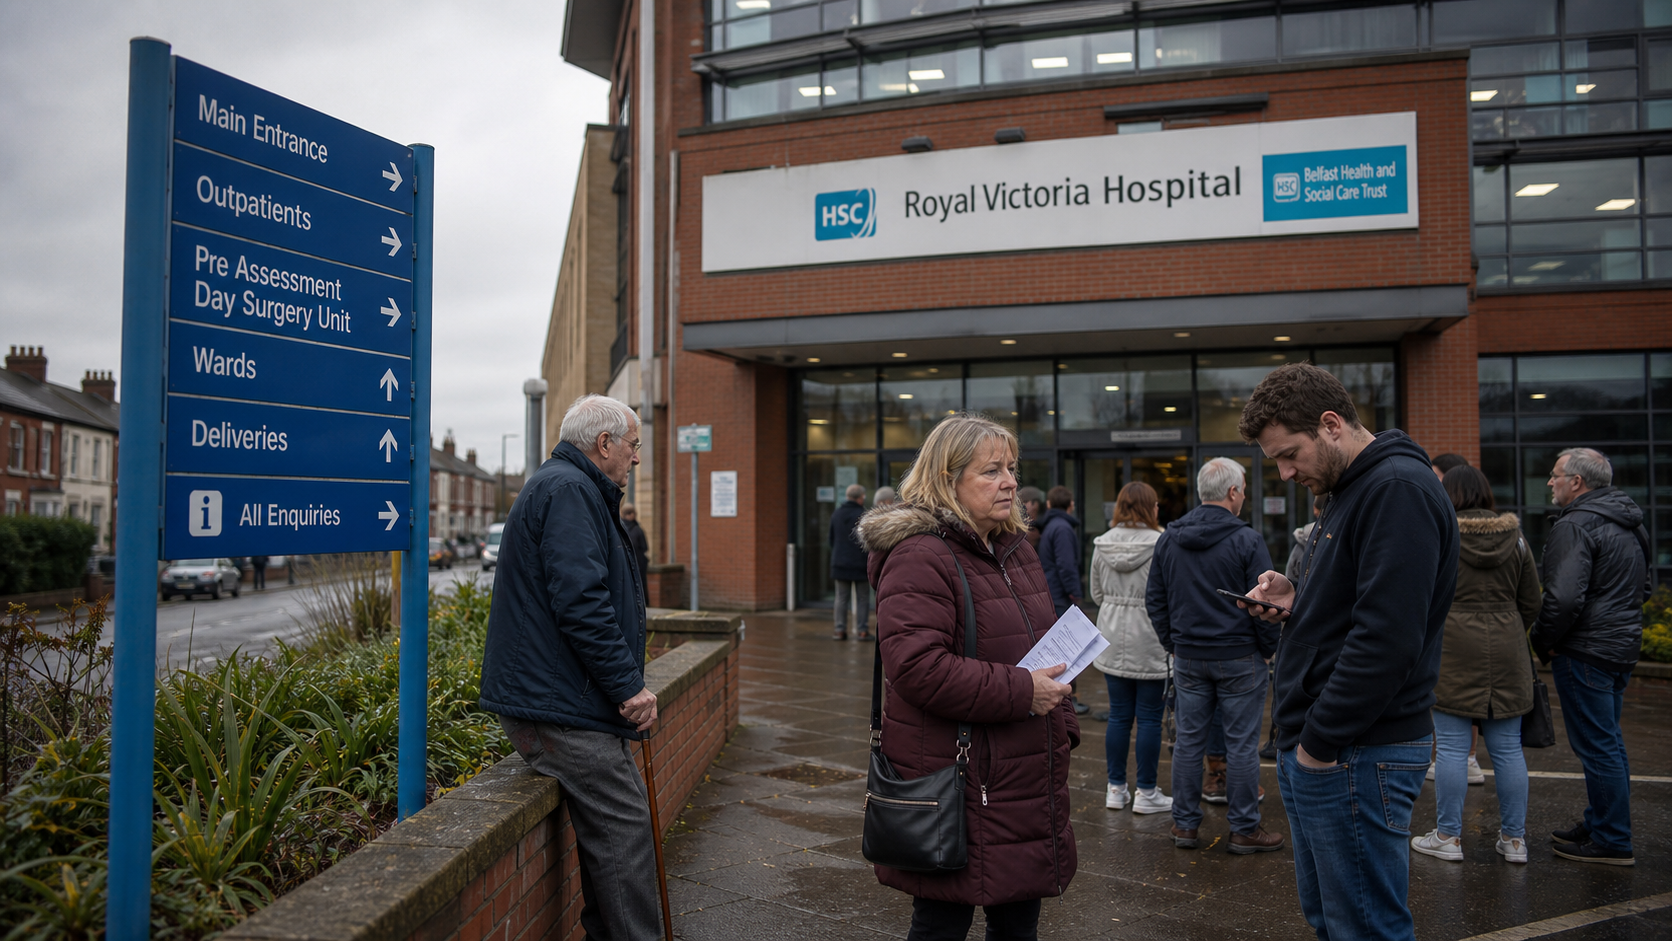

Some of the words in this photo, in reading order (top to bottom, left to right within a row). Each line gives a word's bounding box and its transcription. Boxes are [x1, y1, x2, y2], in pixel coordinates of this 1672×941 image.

[199, 94, 246, 135] Main
[253, 114, 328, 163] Entrance
[1304, 165, 1339, 183] Belfast
[1341, 162, 1374, 180] Health
[1375, 161, 1396, 178] and
[196, 175, 312, 231] Outpatients
[905, 184, 975, 223] Royal
[982, 177, 1090, 211] Victoria
[1104, 165, 1241, 208] Hospital
[1304, 185, 1334, 203] Social
[1335, 184, 1360, 200] Care
[1361, 183, 1388, 199] Trust
[822, 202, 863, 227] HSC
[195, 244, 229, 277] Pre
[234, 254, 342, 301] Assessment
[195, 280, 236, 318] Day
[242, 289, 313, 331] Surgery
[317, 304, 351, 334] Unit
[193, 345, 257, 379] Wards
[192, 419, 288, 451] Deliveries
[239, 503, 262, 526] All
[267, 503, 341, 531] Enquiries
